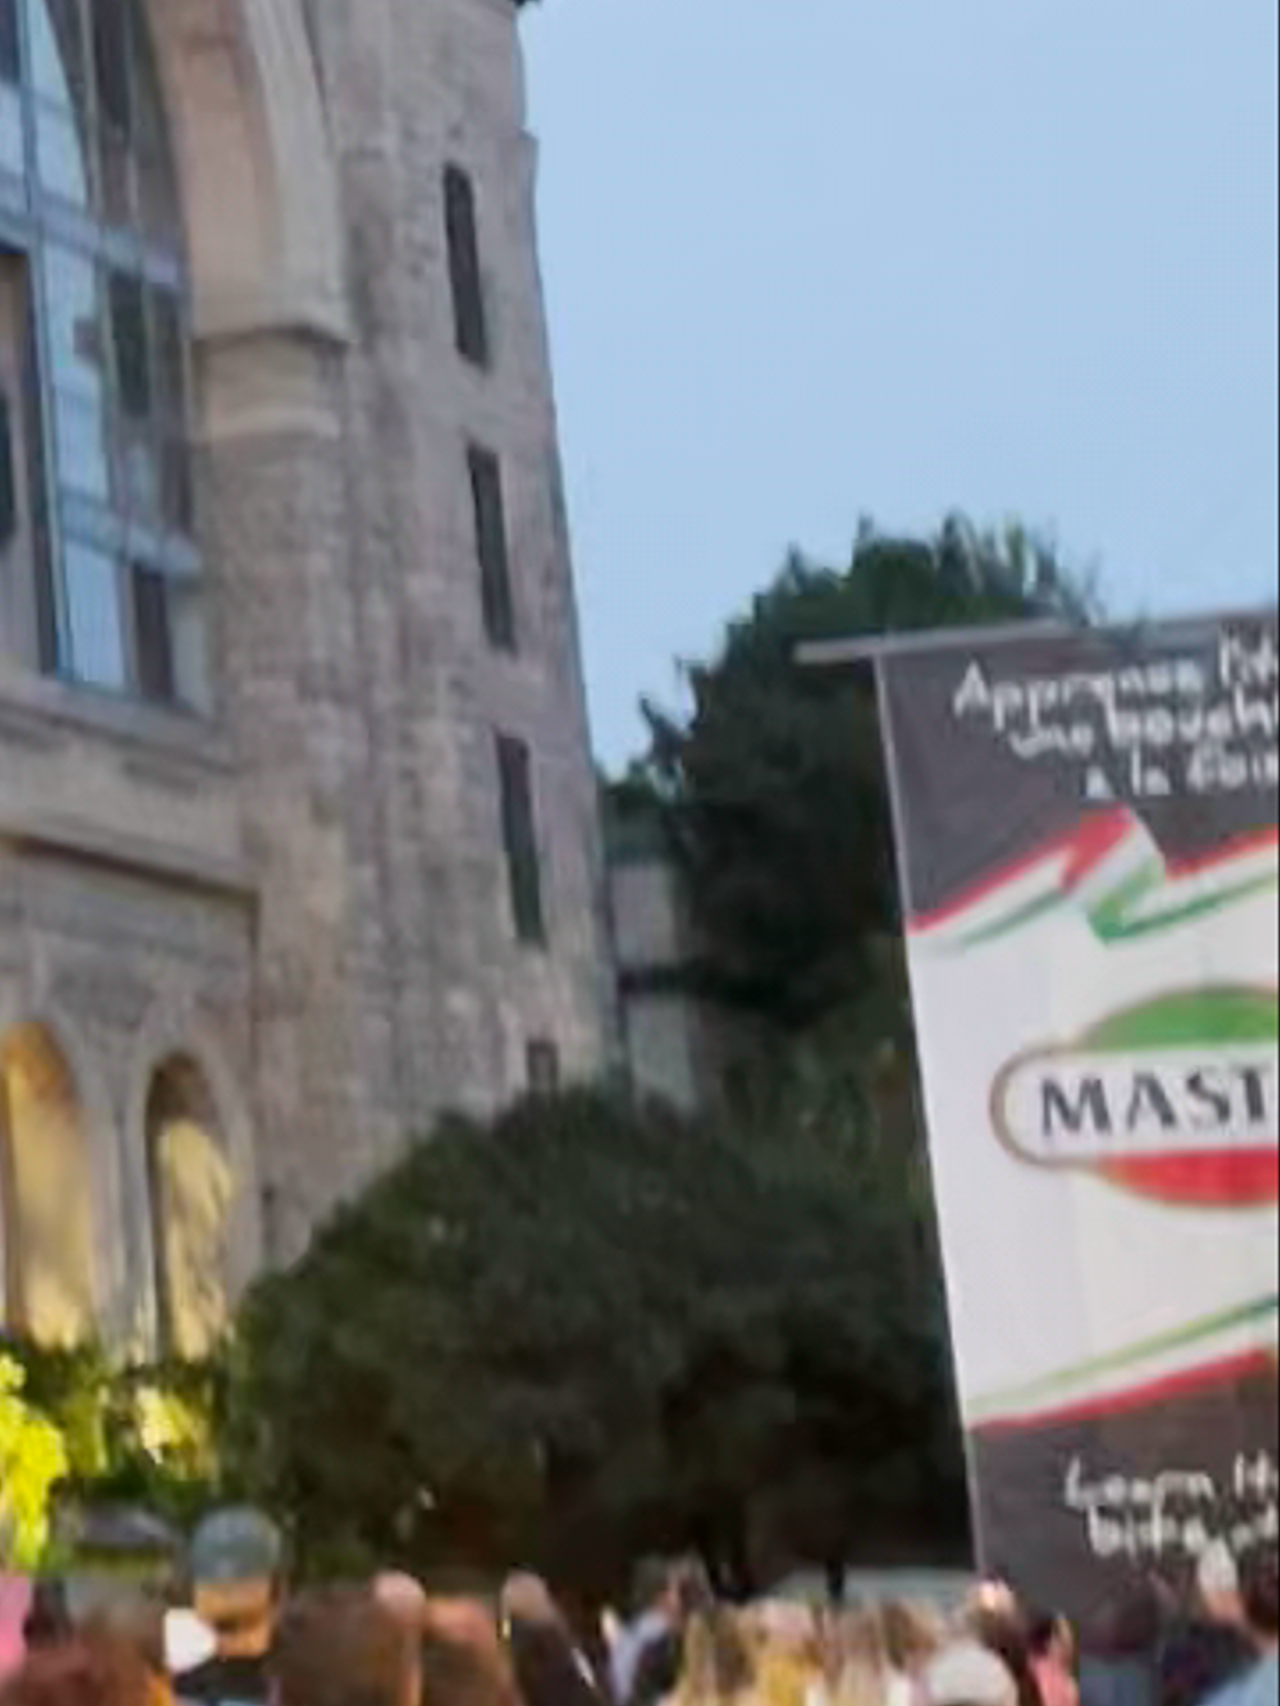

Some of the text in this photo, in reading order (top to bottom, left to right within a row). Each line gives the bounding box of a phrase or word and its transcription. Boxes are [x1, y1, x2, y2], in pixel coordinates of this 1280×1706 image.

[1098, 676, 1279, 749] bouch
[1041, 1066, 1273, 1136] MAST
[1064, 1455, 1215, 1508] Learn
